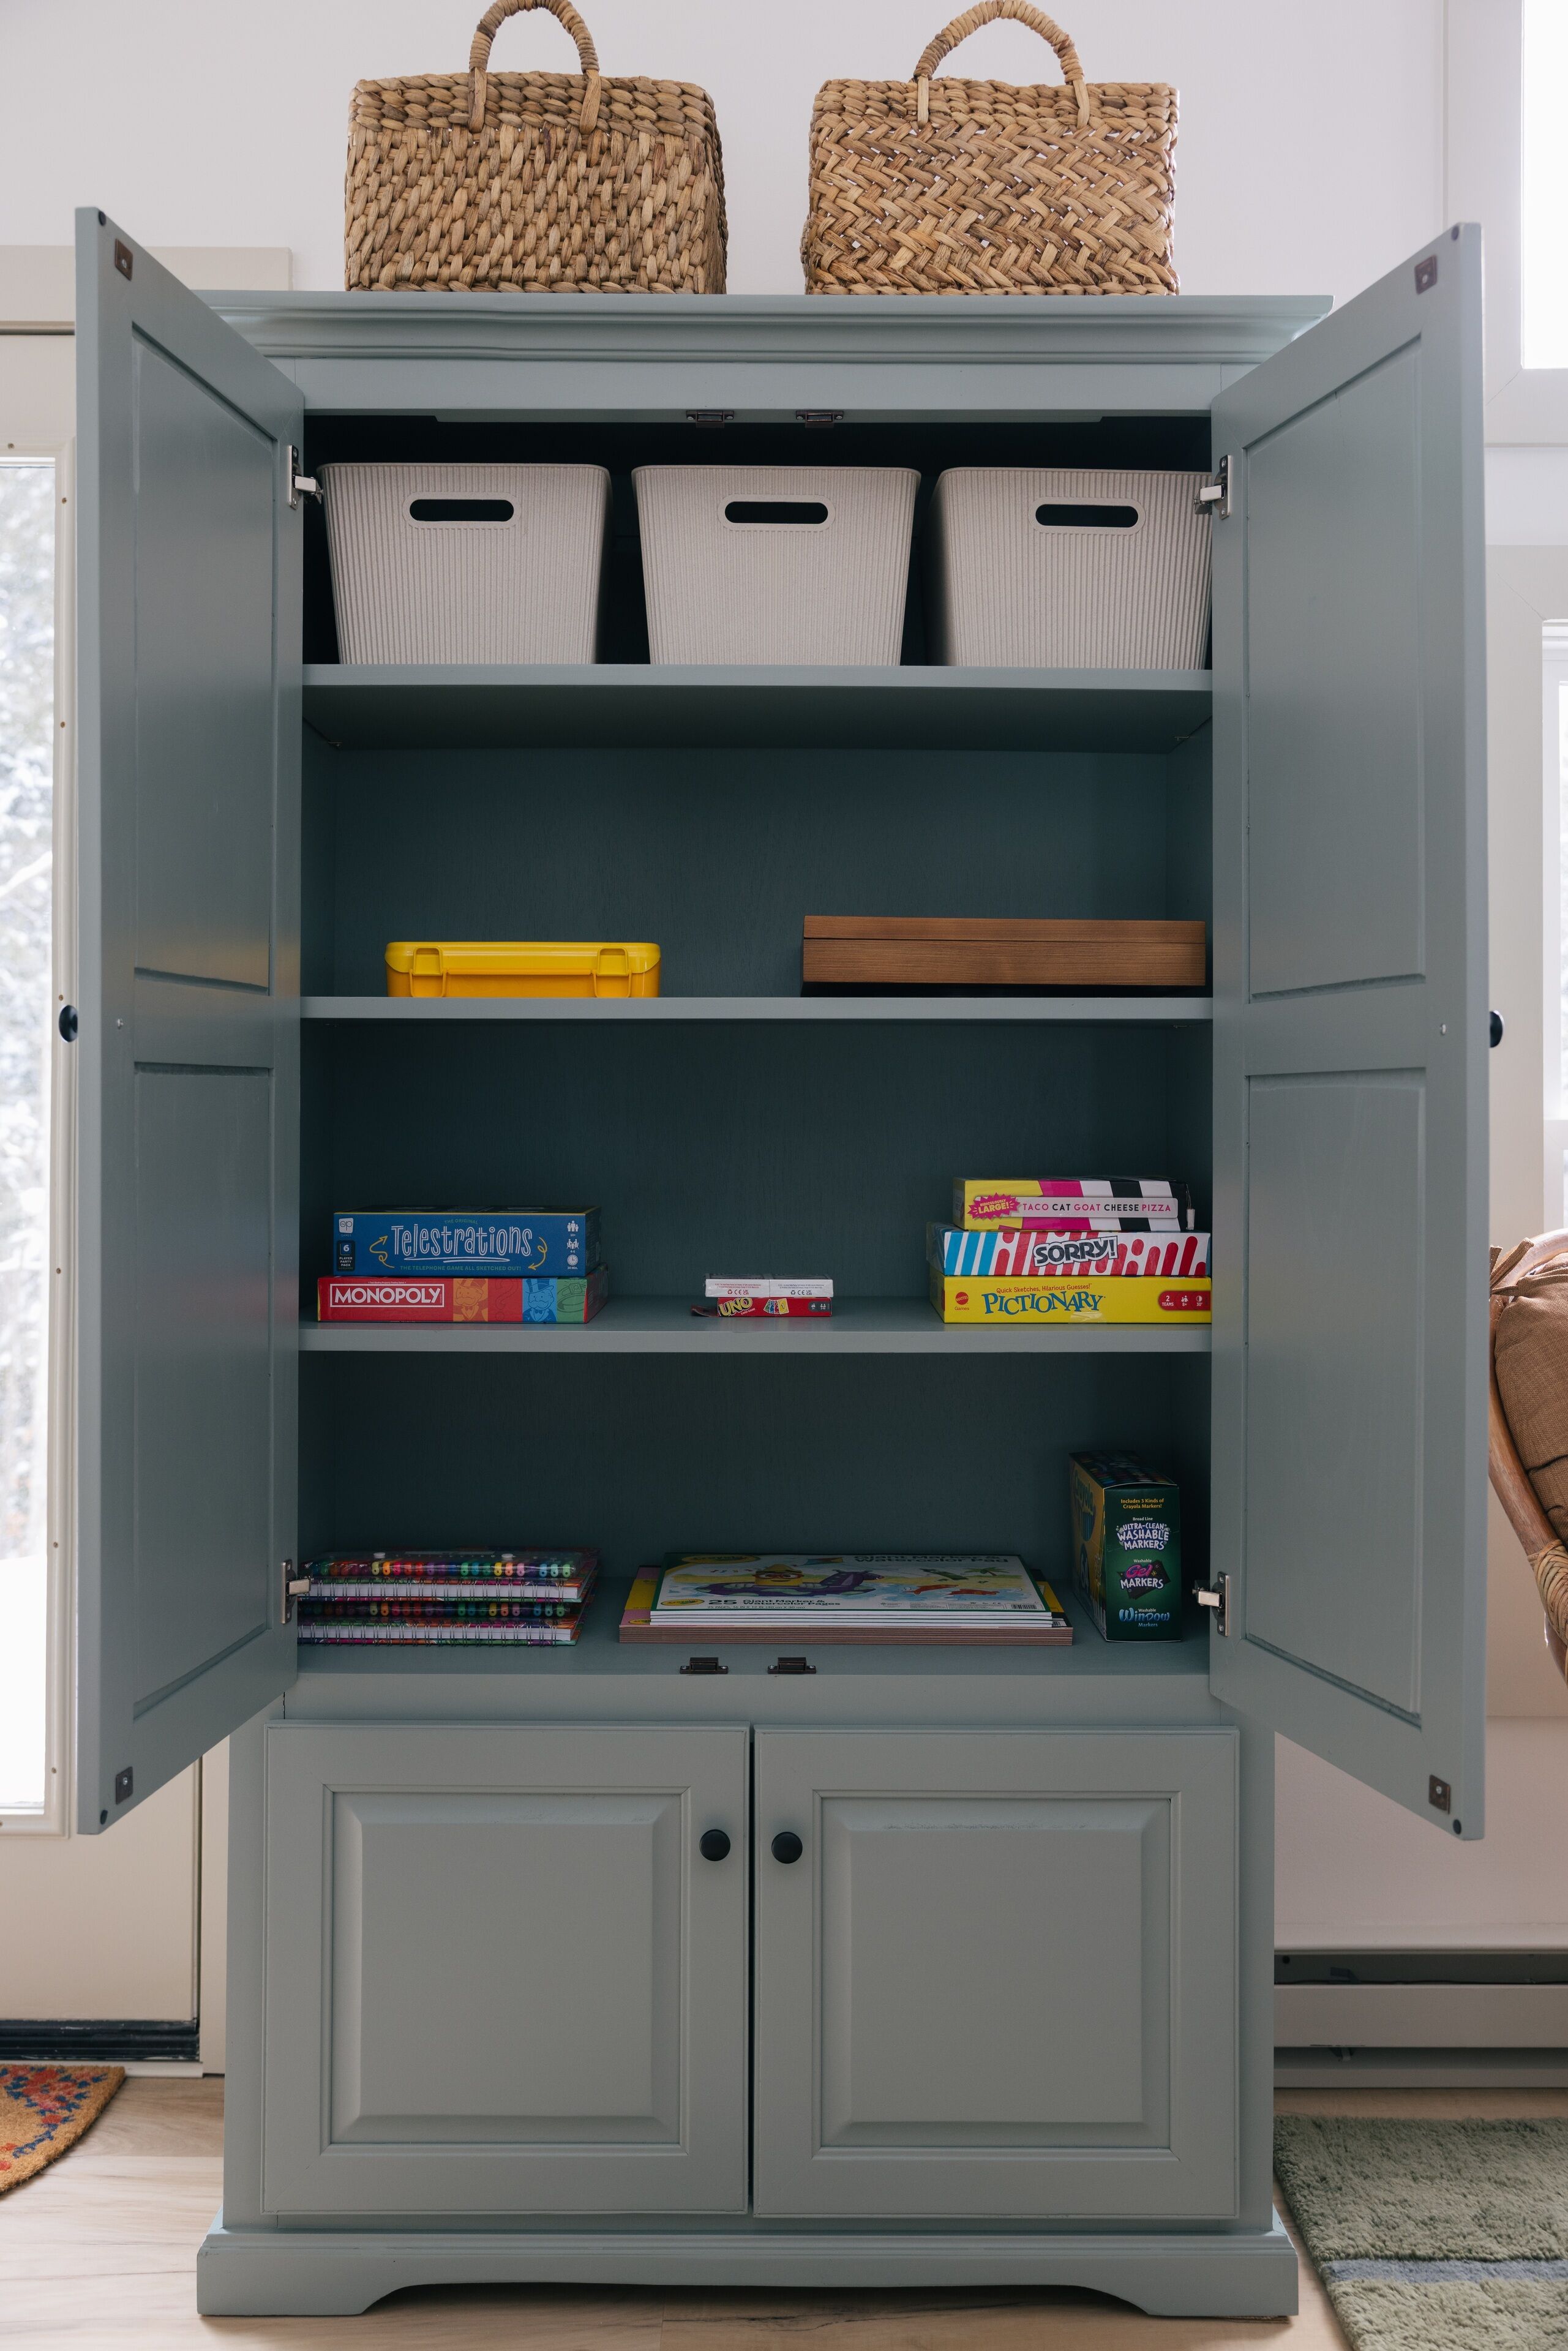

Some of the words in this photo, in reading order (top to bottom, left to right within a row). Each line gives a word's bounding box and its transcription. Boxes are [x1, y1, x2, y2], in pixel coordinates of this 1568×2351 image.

[978, 1202, 1010, 1213] LARGE!
[980, 1198, 1006, 1207] RIDICULOUSLY
[391, 1224, 533, 1258] Telestrations
[1035, 1237, 1117, 1265] SORRY!
[334, 1287, 441, 1303] MONOPOLY
[718, 1297, 752, 1316] UNO
[981, 1291, 1104, 1315] PICTIONARY
[1122, 1522, 1165, 1531] ULTRA-CLEAN
[1117, 1529, 1169, 1542] WASHABLE
[1123, 1539, 1165, 1551] MARKERS
[1125, 1564, 1153, 1578] Gel
[1120, 1577, 1164, 1589] MARKERS
